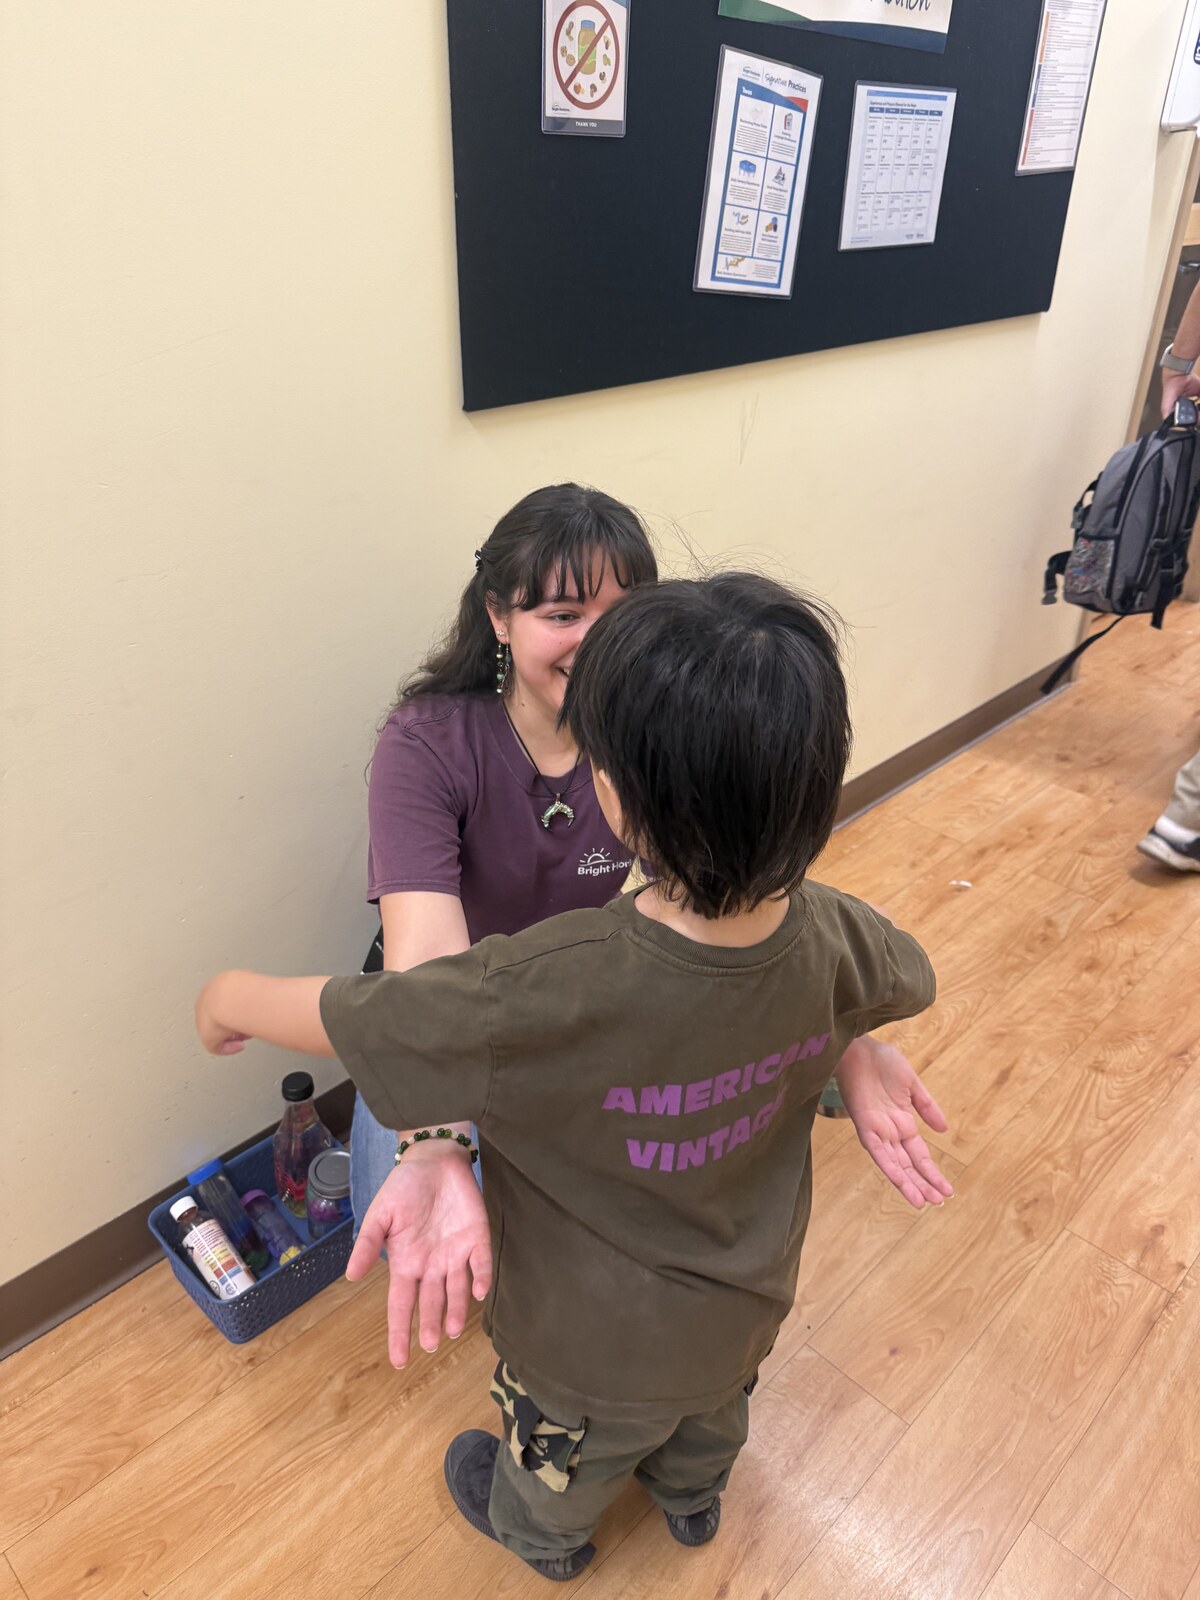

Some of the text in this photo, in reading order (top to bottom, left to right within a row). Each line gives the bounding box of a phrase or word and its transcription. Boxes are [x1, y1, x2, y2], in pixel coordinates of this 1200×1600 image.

[577, 865, 611, 877] Bright
[601, 1032, 832, 1116] AMERICAN
[626, 1086, 786, 1172] VINTAG
